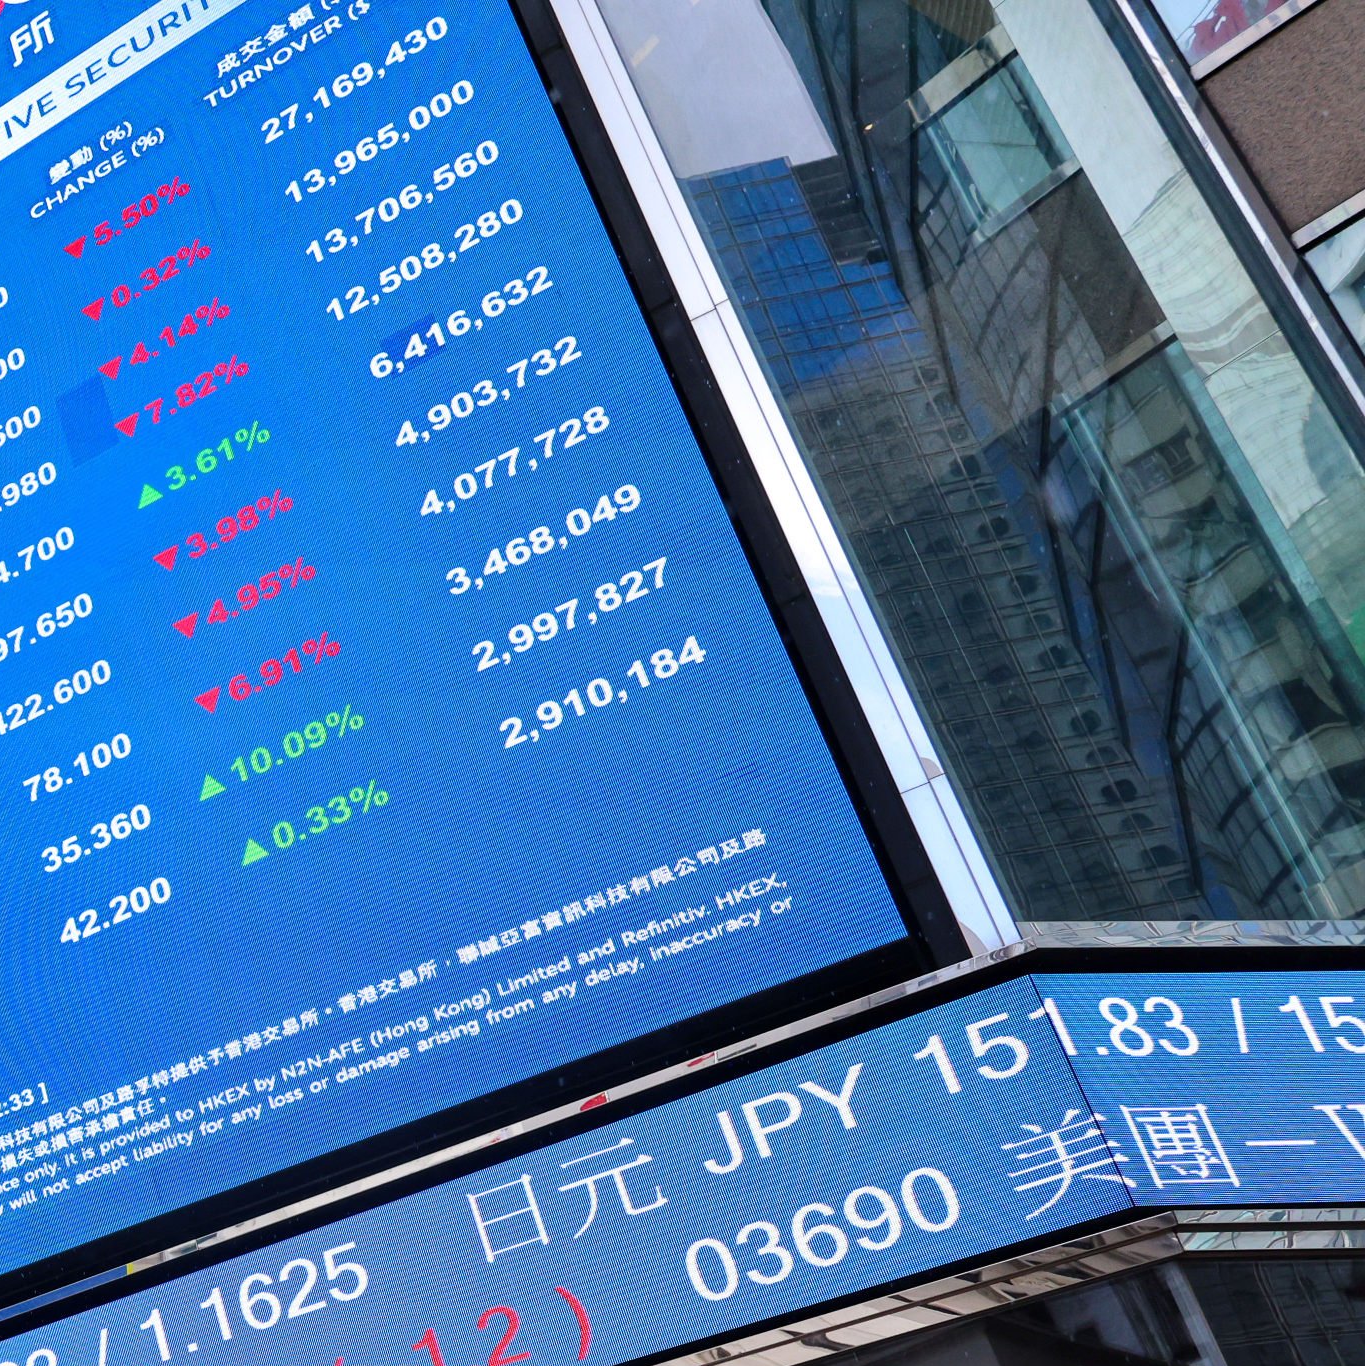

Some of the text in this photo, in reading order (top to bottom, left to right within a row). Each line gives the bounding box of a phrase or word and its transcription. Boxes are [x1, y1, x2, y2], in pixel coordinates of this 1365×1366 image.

[203, 15, 343, 107] TURNOVER
[261, 16, 448, 144] 27,169,430
[285, 79, 475, 203] 13,965,000
[30, 150, 127, 219] CHANGE
[93, 176, 191, 246] 5.50%
[305, 140, 499, 263] 13,706,560
[110, 238, 212, 308] 0.32%
[326, 198, 523, 321] 12,508,280
[129, 297, 231, 366] 4.14%
[369, 265, 553, 379] 6,416,632
[144, 354, 250, 425] 7.82%
[395, 335, 582, 447] 4,903,732
[165, 420, 272, 491] 3.61%
[420, 405, 610, 516] 4,077,728
[185, 489, 294, 559] 3.98%
[446, 484, 641, 595] 3,468,049
[206, 556, 317, 625] 4.95%
[471, 556, 667, 672] 2,997,827
[228, 631, 341, 702] 6.91%
[499, 635, 706, 749] 2,910,184
[22, 732, 132, 802] 78.100
[230, 704, 366, 782] 10.09%
[41, 803, 152, 873] 35.360
[271, 779, 390, 850] 0.33%
[60, 877, 172, 943] 42.200
[23, 1162, 58, 1184] only.
[140, 1241, 369, 1362] 1.1625
[465, 1137, 669, 1264] 日元
[703, 1063, 863, 1175] JPY
[685, 1167, 961, 1302] 03690
